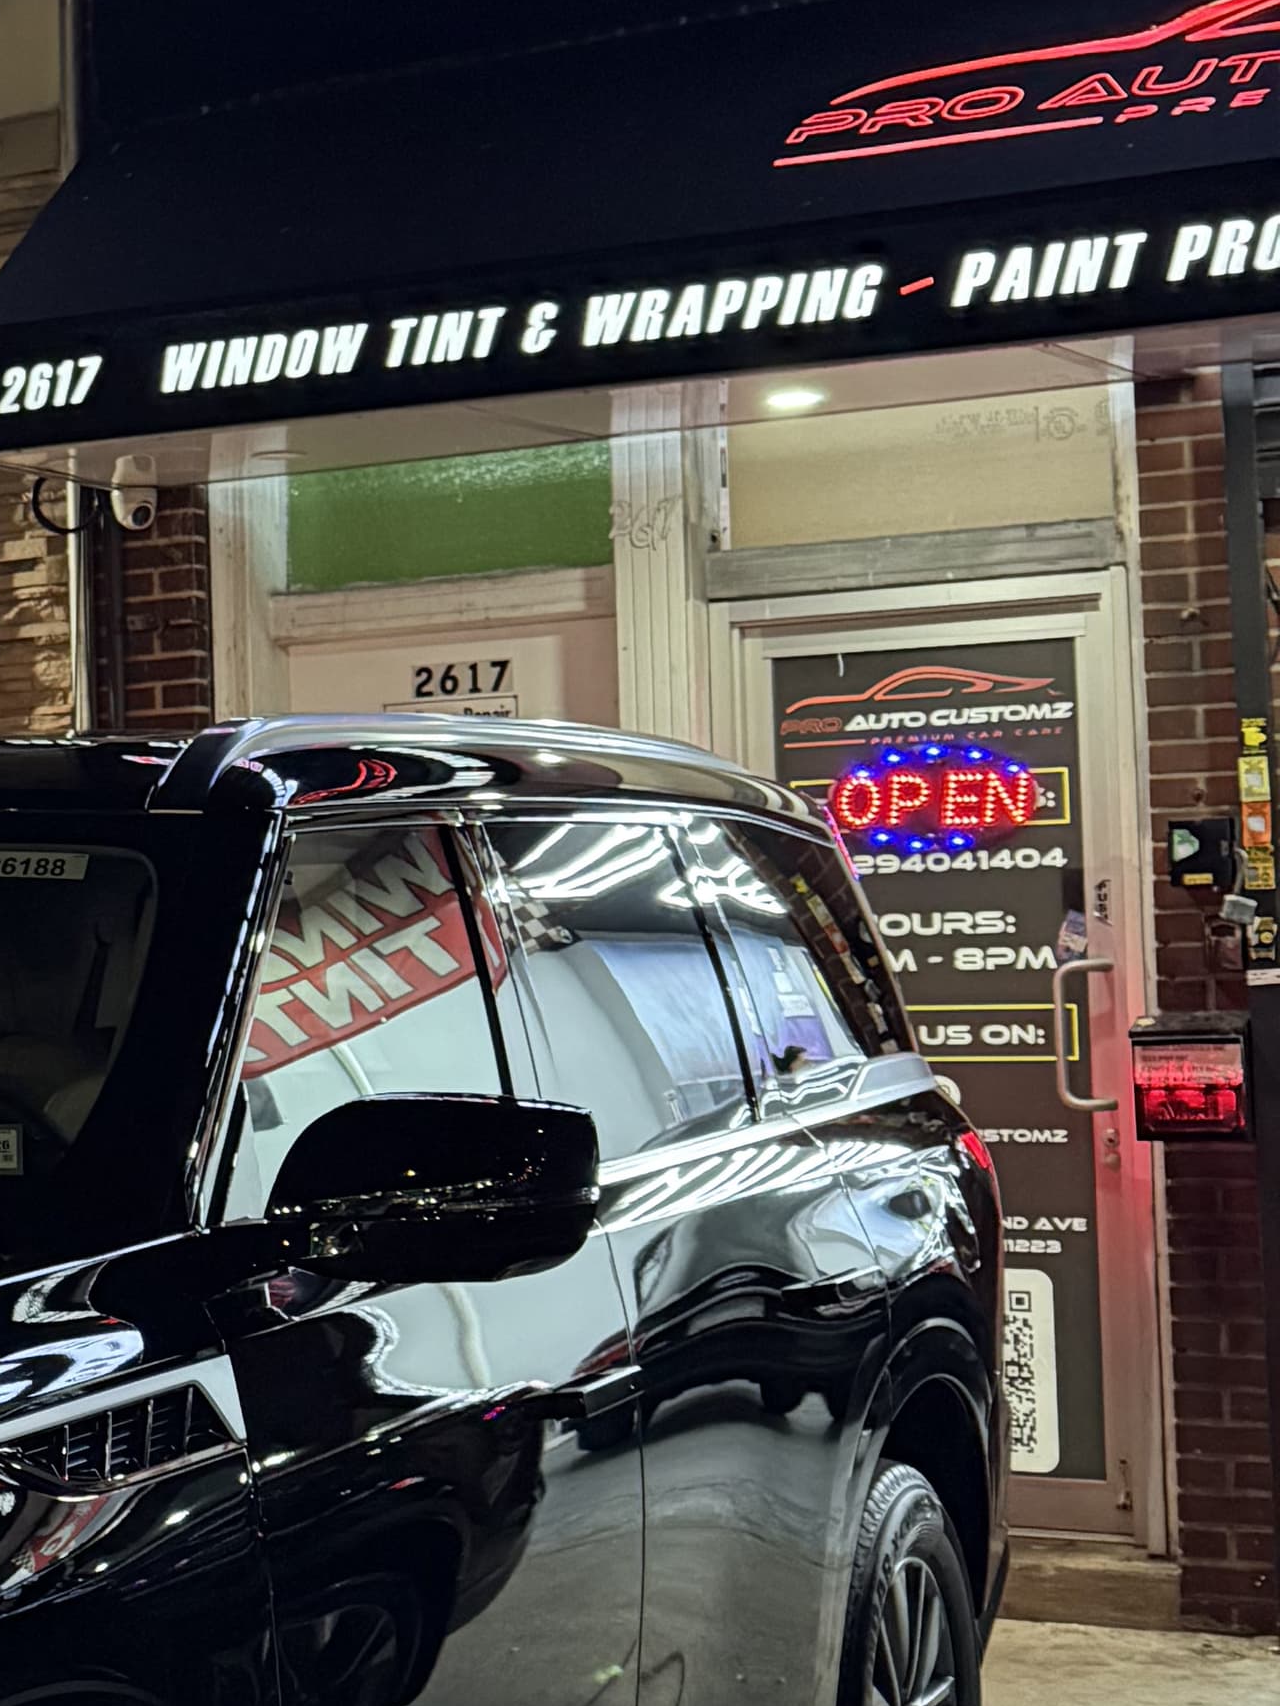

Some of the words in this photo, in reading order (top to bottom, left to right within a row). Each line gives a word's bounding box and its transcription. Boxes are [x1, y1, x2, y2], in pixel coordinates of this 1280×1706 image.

[785, 85, 1025, 145] PRO
[159, 322, 369, 394] WINDOW
[384, 306, 508, 369] TINT
[519, 300, 561, 355] &
[582, 263, 885, 349] WRAPPING
[949, 230, 1148, 309] PAINT
[415, 659, 511, 698] 2617
[780, 718, 841, 736] PRO
[844, 709, 927, 733] AUTO
[929, 701, 1075, 726] CUSTOMZ
[966, 729, 1004, 741] CAR
[836, 769, 1033, 831] OPEN
[872, 910, 1017, 937] OURS:
[952, 945, 1058, 971] 8PM
[917, 1024, 973, 1046] US
[980, 1024, 1046, 1045] ON:
[1033, 1216, 1087, 1231] AVE
